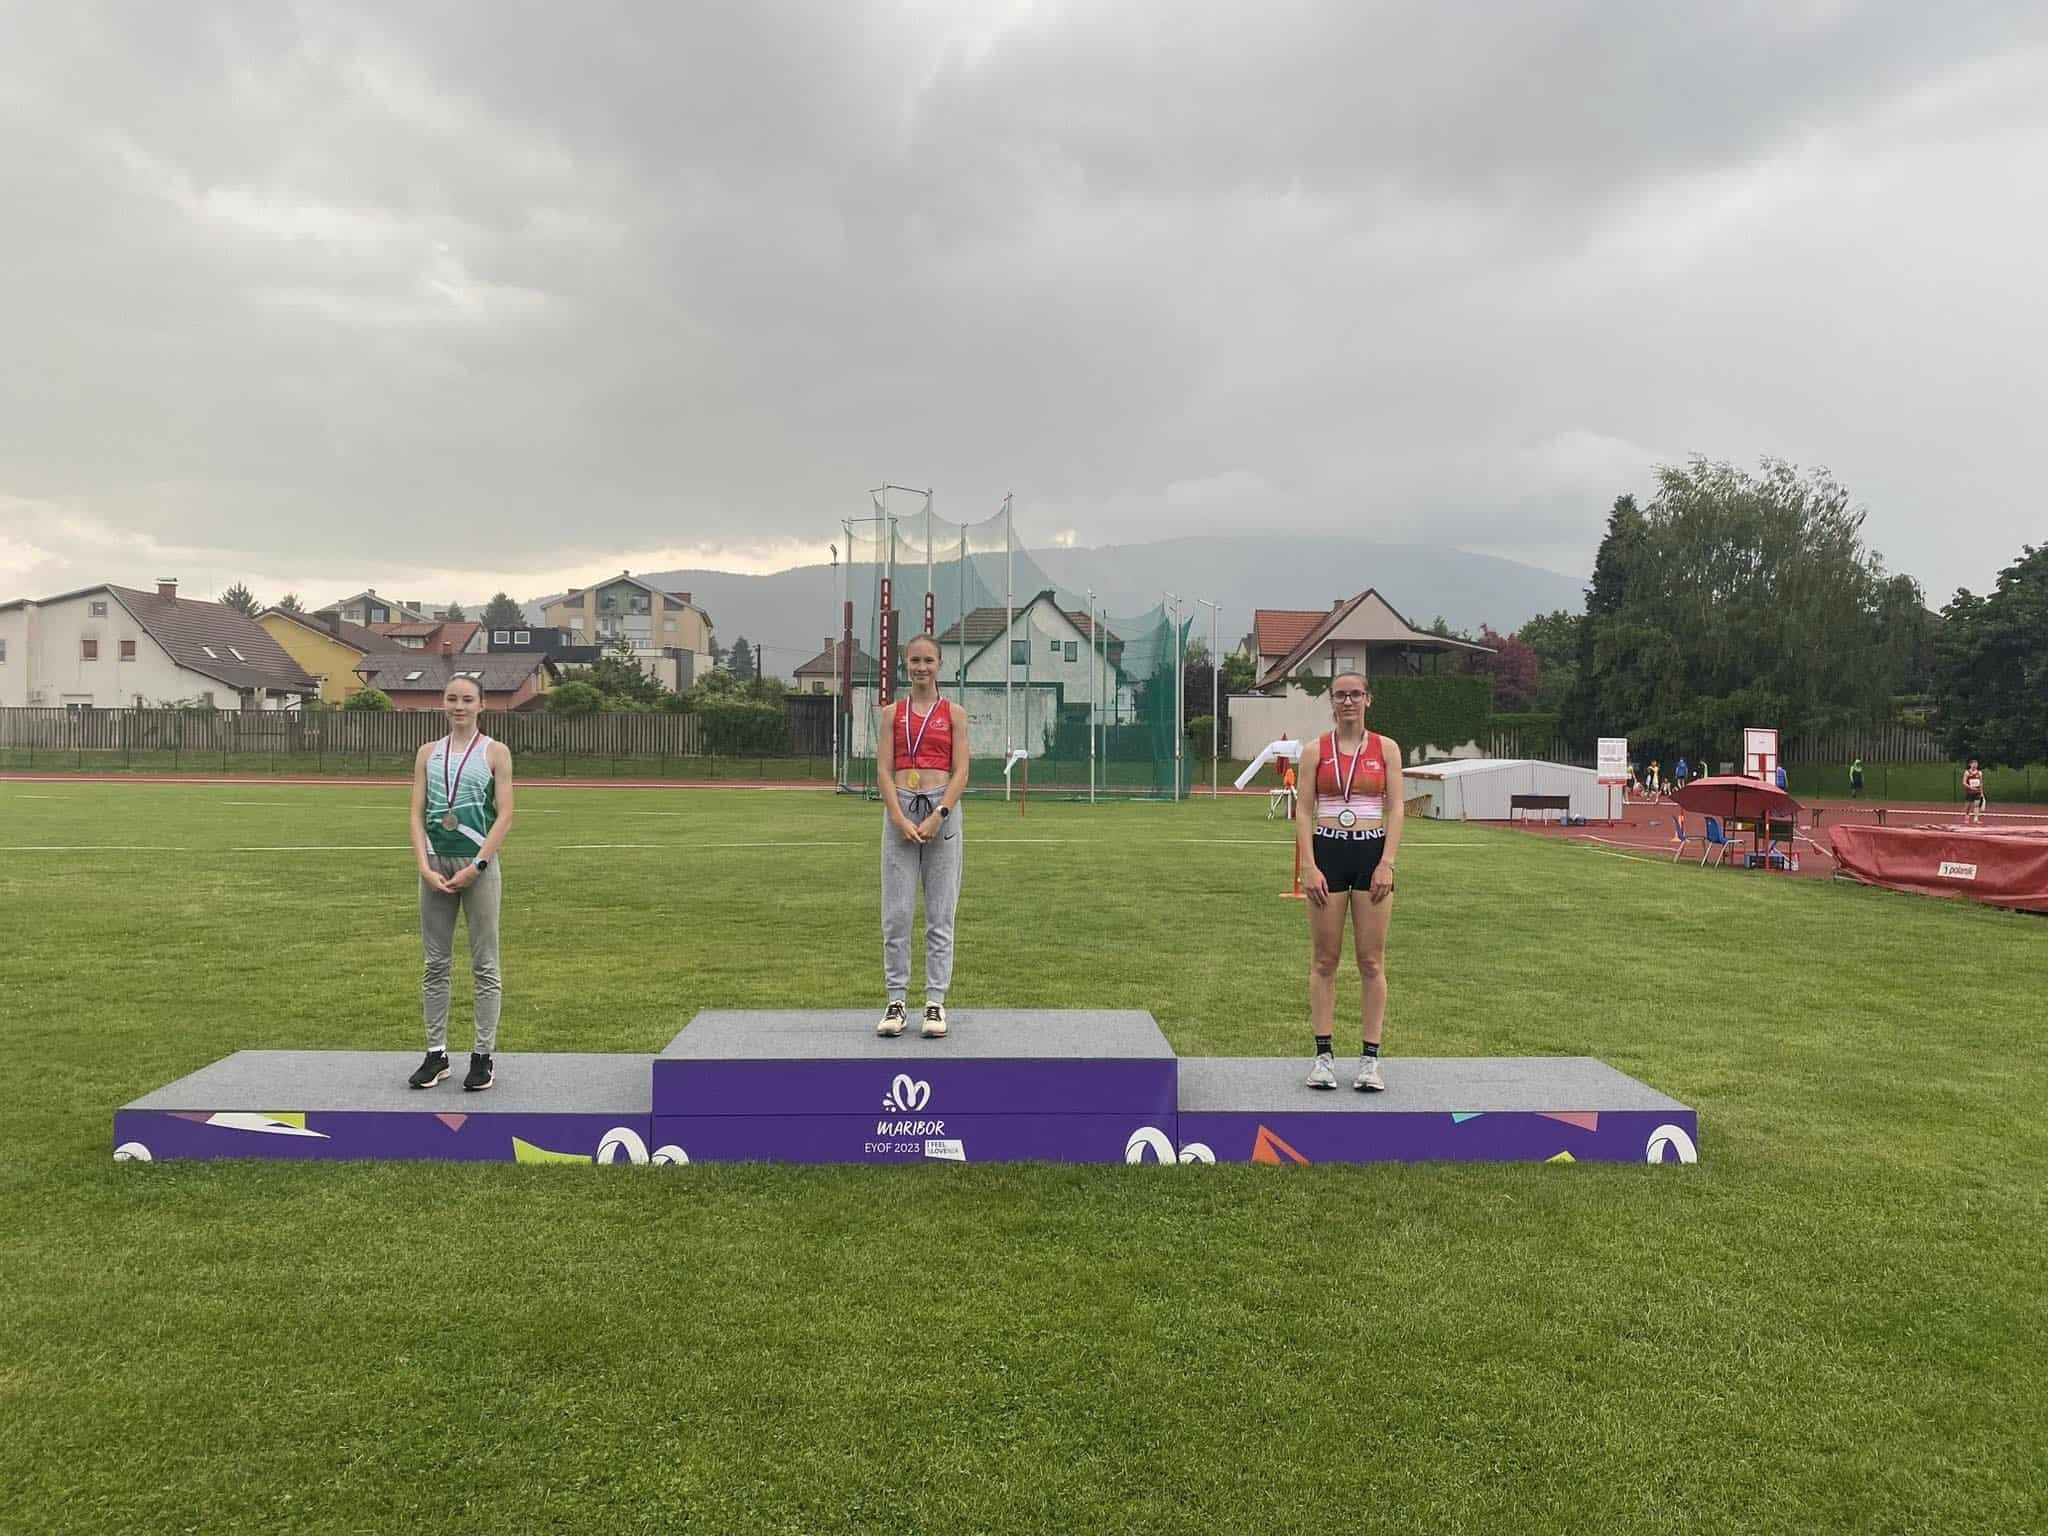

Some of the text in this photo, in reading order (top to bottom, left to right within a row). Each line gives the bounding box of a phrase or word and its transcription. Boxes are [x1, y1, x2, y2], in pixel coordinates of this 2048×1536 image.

[877, 1120, 945, 1136] MARIBOR
[865, 1143, 920, 1153] EYOF 2023
